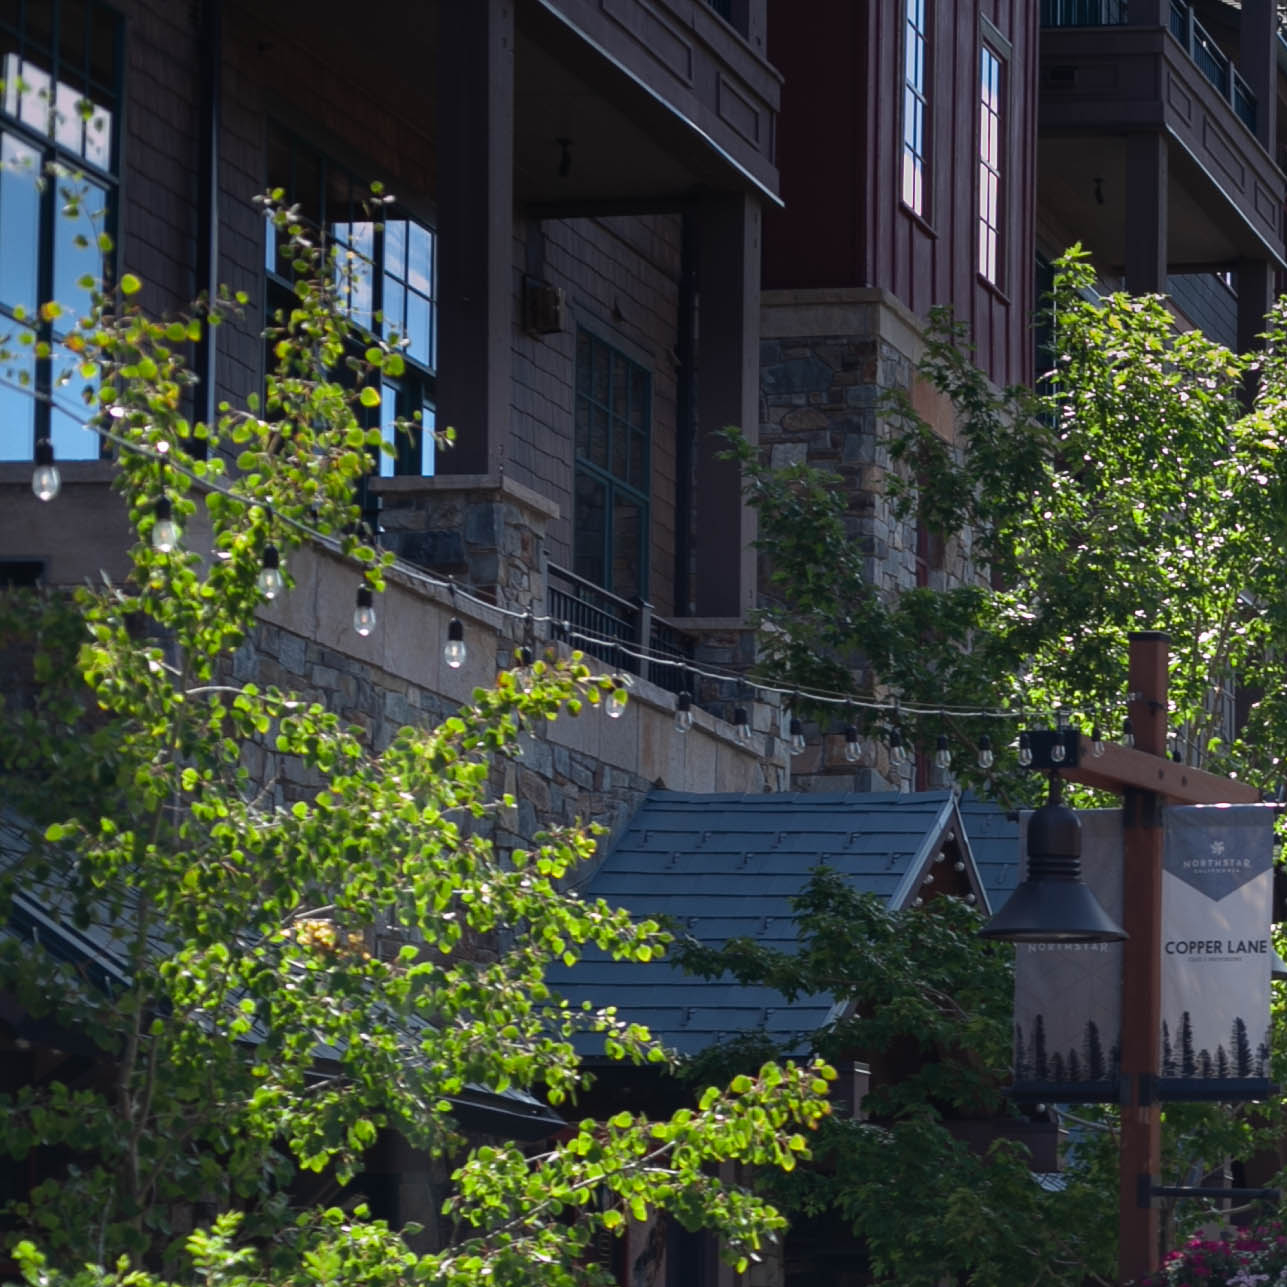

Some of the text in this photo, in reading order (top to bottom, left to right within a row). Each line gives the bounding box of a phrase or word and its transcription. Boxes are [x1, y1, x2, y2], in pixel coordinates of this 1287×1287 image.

[1183, 858, 1251, 868] NORTHSTAR
[1165, 940, 1268, 954] COPPER LANE
